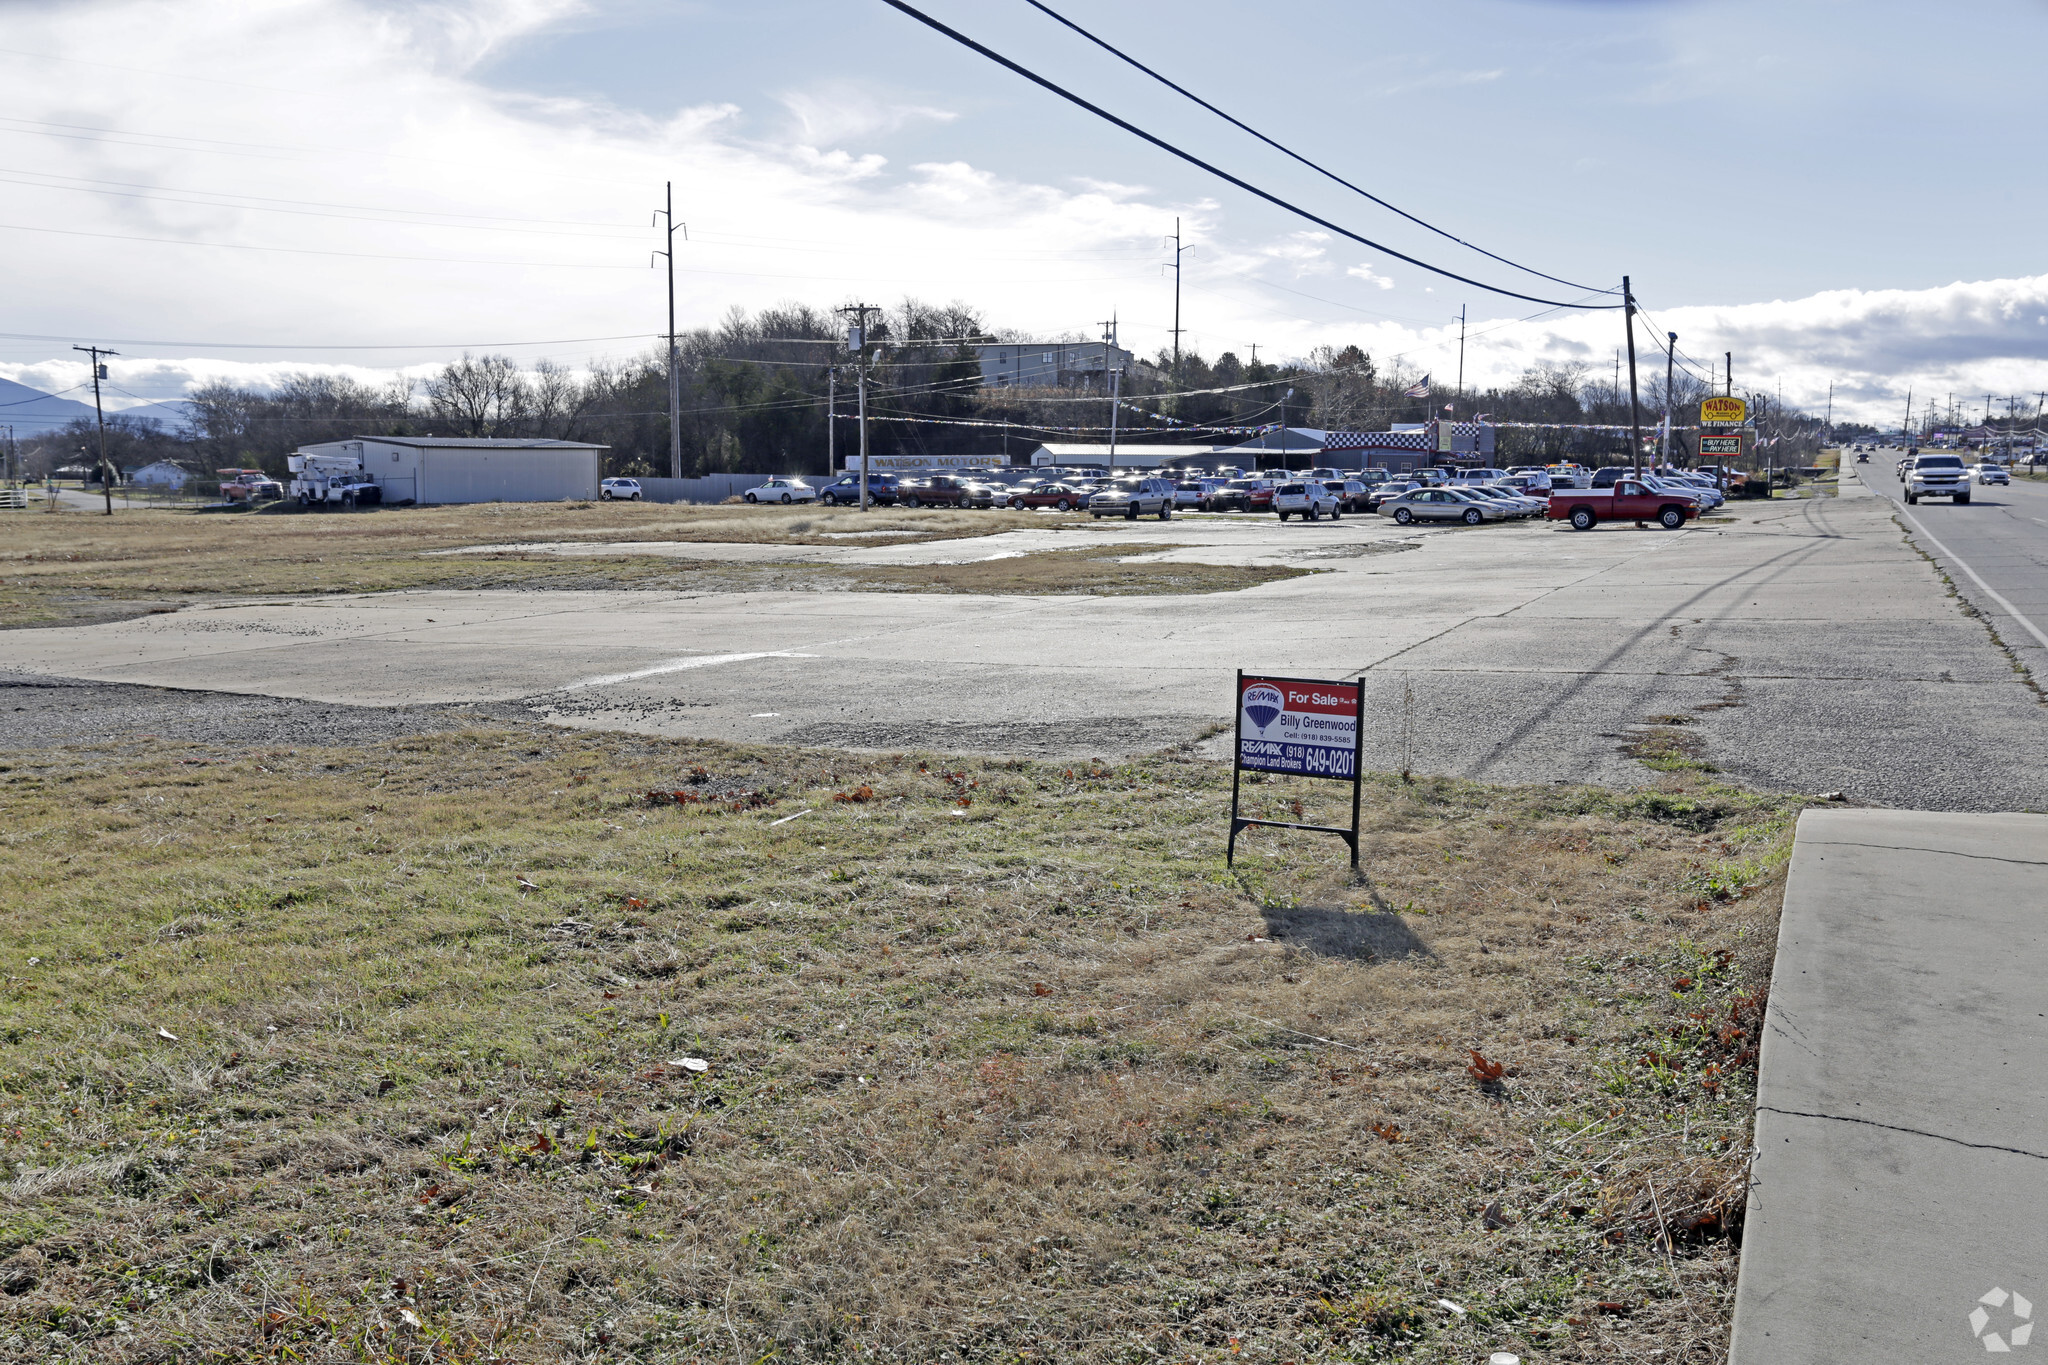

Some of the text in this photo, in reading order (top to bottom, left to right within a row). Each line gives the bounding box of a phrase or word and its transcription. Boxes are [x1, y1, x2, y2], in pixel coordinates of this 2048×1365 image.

[1706, 399, 1740, 411] WATSON
[874, 457, 1002, 467] WATSON MOTORS
[1247, 690, 1280, 704] RE/MAX
[1288, 691, 1309, 704] For
[1312, 692, 1338, 706] Sale
[1280, 714, 1356, 732] Billy Greenwood
[1284, 731, 1351, 744] Cell: (918) 839-5585
[1241, 740, 1283, 755] RE/MAX
[1240, 753, 1302, 770] Champion Land Brokers
[1286, 745, 1355, 774] (918) 649-0201
